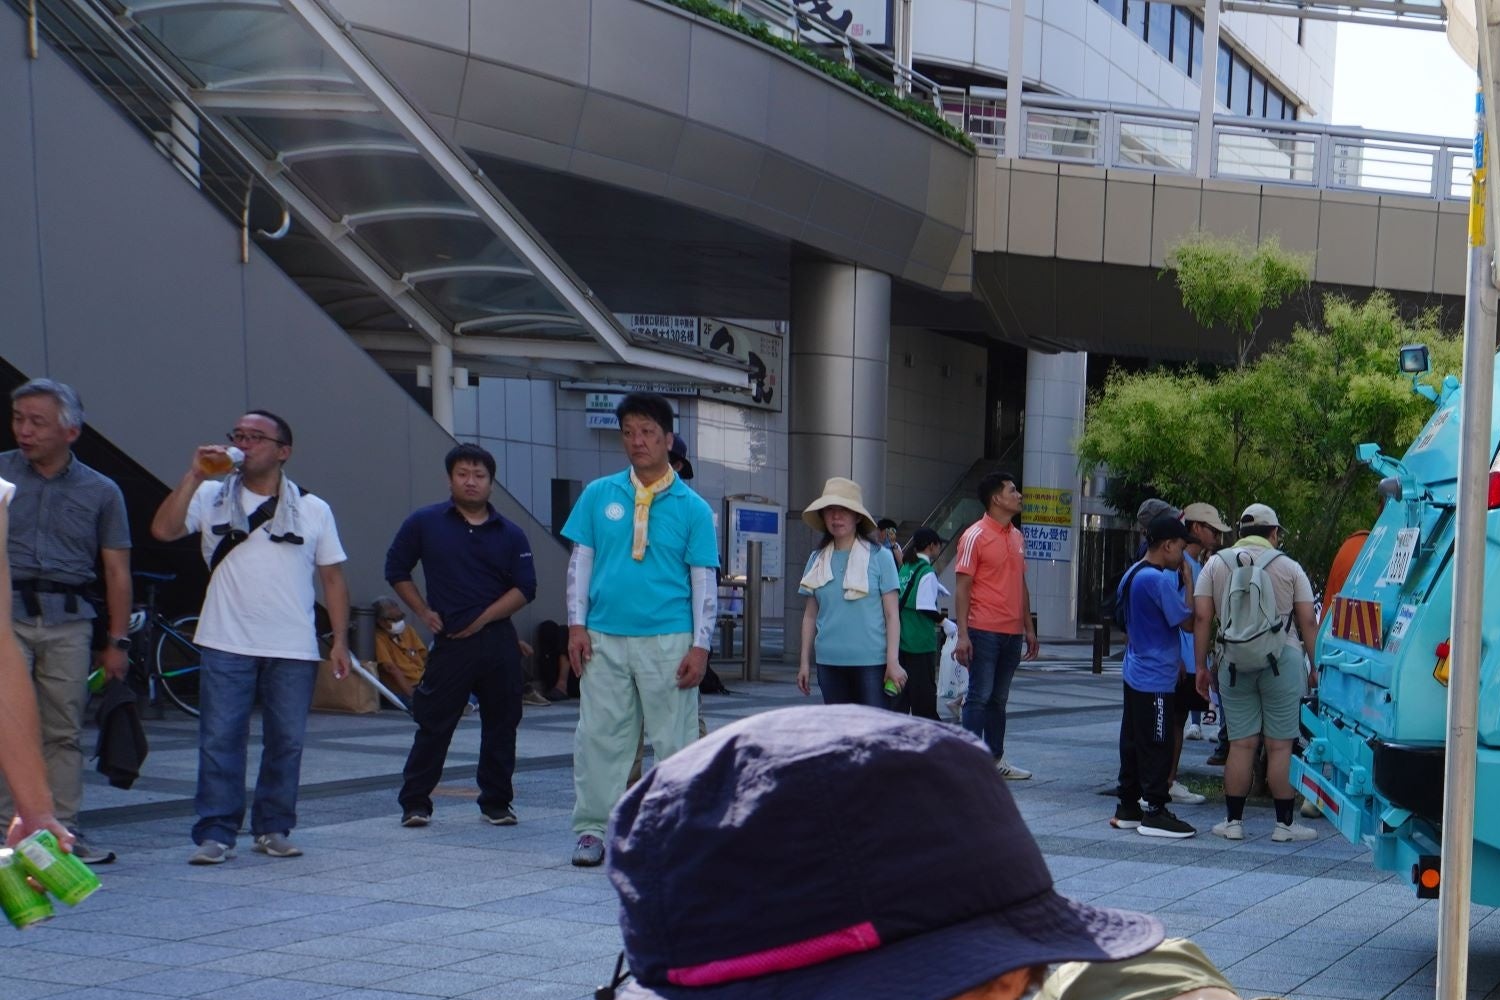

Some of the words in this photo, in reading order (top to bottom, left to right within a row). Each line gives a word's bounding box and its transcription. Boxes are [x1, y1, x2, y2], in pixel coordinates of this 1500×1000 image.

[703, 322, 713, 335] 2F
[1022, 526, 1068, 541] 方せん受付
